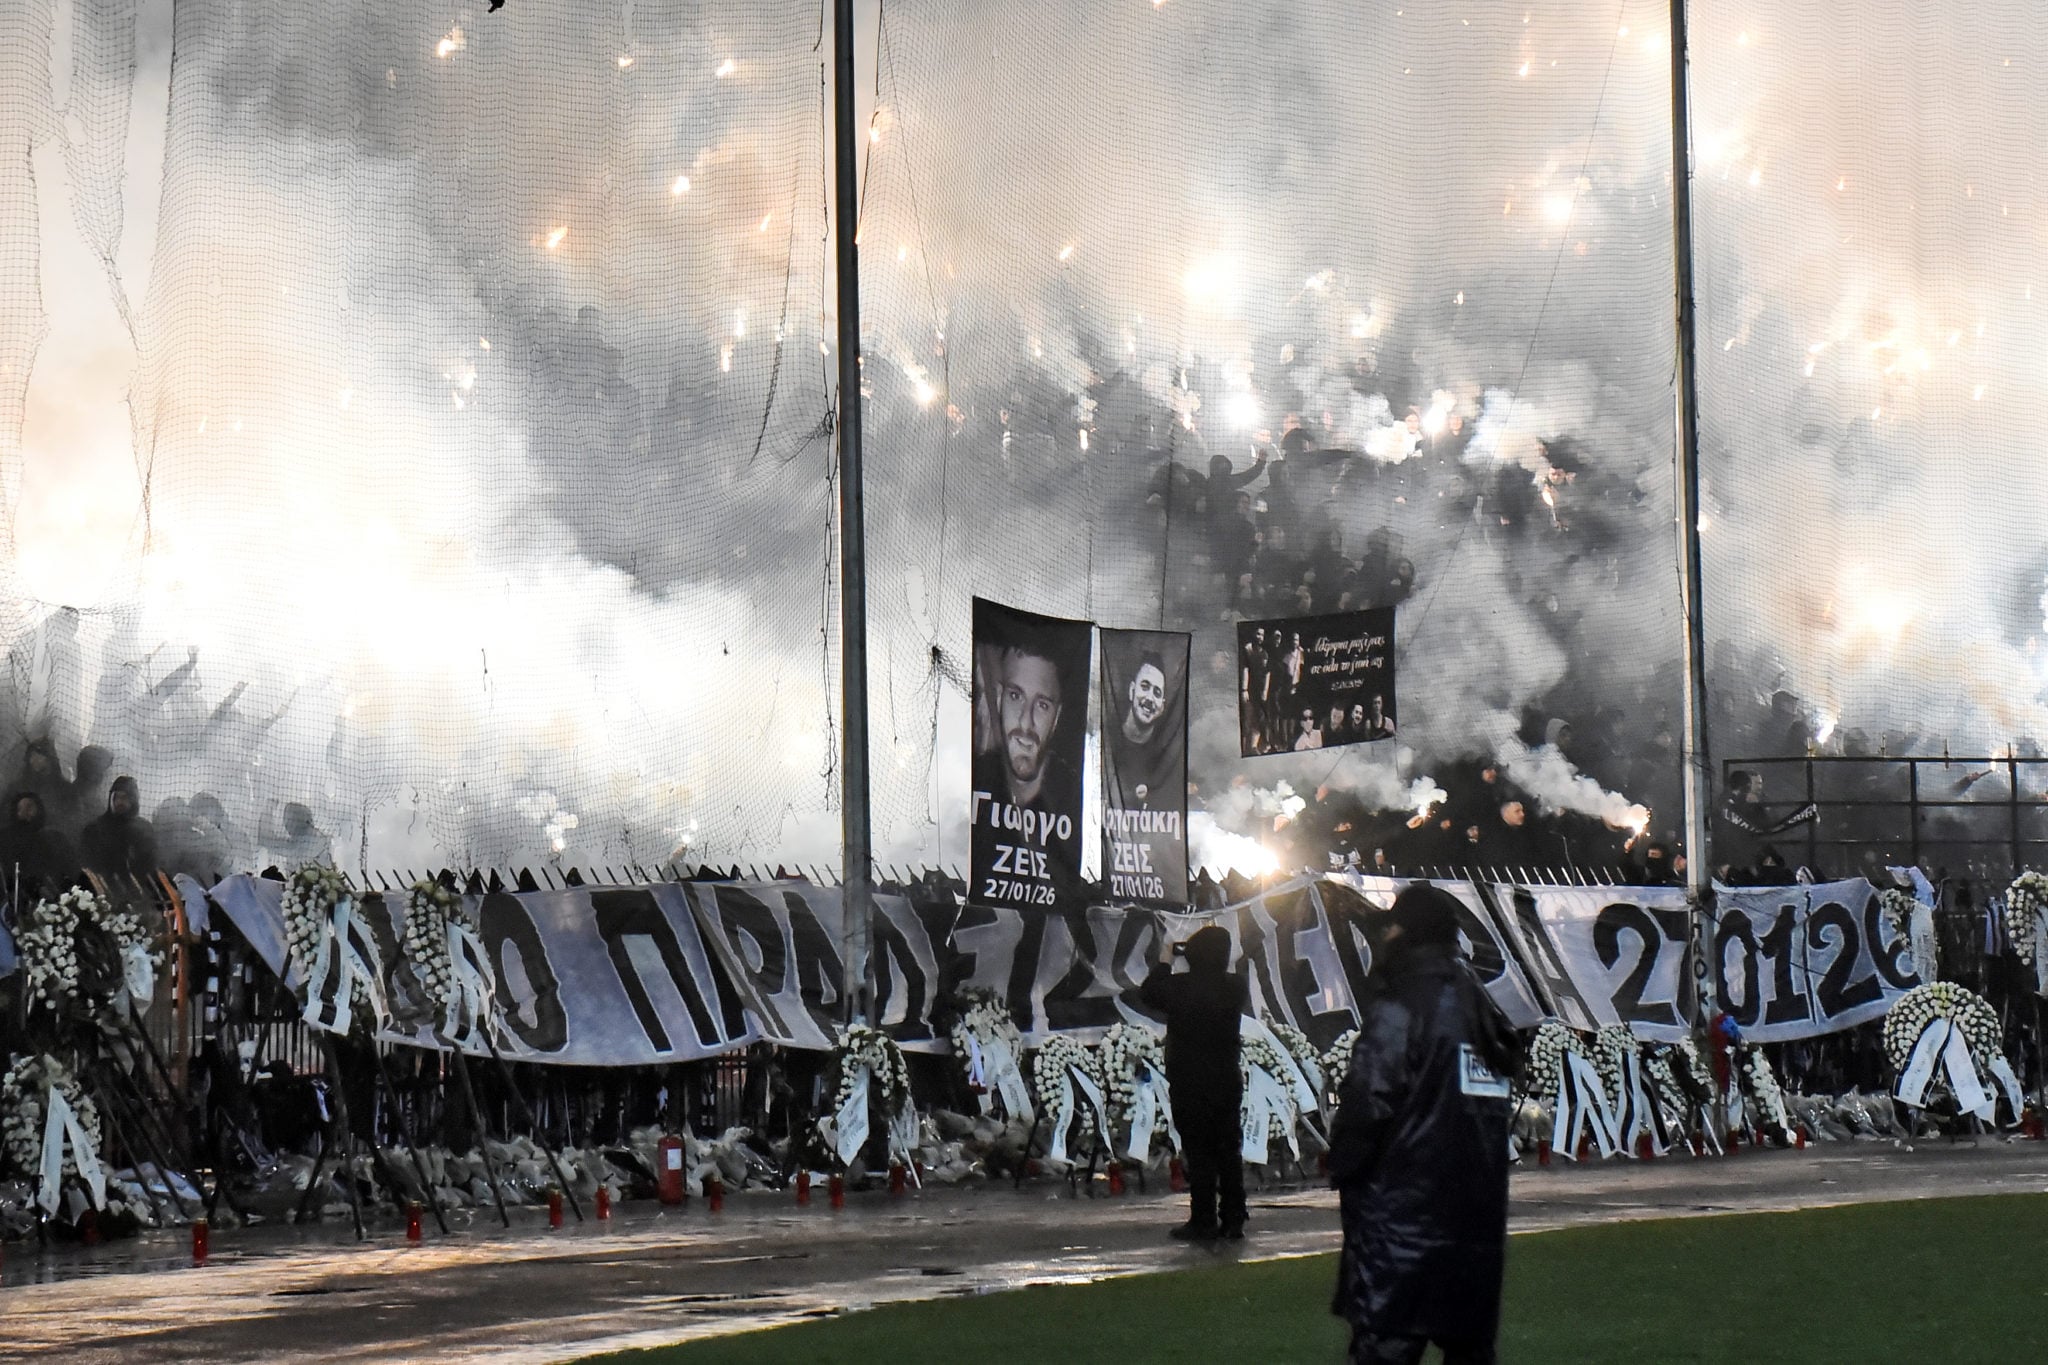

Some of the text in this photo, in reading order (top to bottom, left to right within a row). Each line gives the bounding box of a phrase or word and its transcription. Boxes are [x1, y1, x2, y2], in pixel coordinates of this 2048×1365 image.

[992, 844, 1052, 880] ΖΕΙΣ
[1113, 842, 1154, 873] ΖΕΙΣ
[983, 878, 1056, 906] 27/01/26
[1110, 874, 1164, 899] 27/01/26
